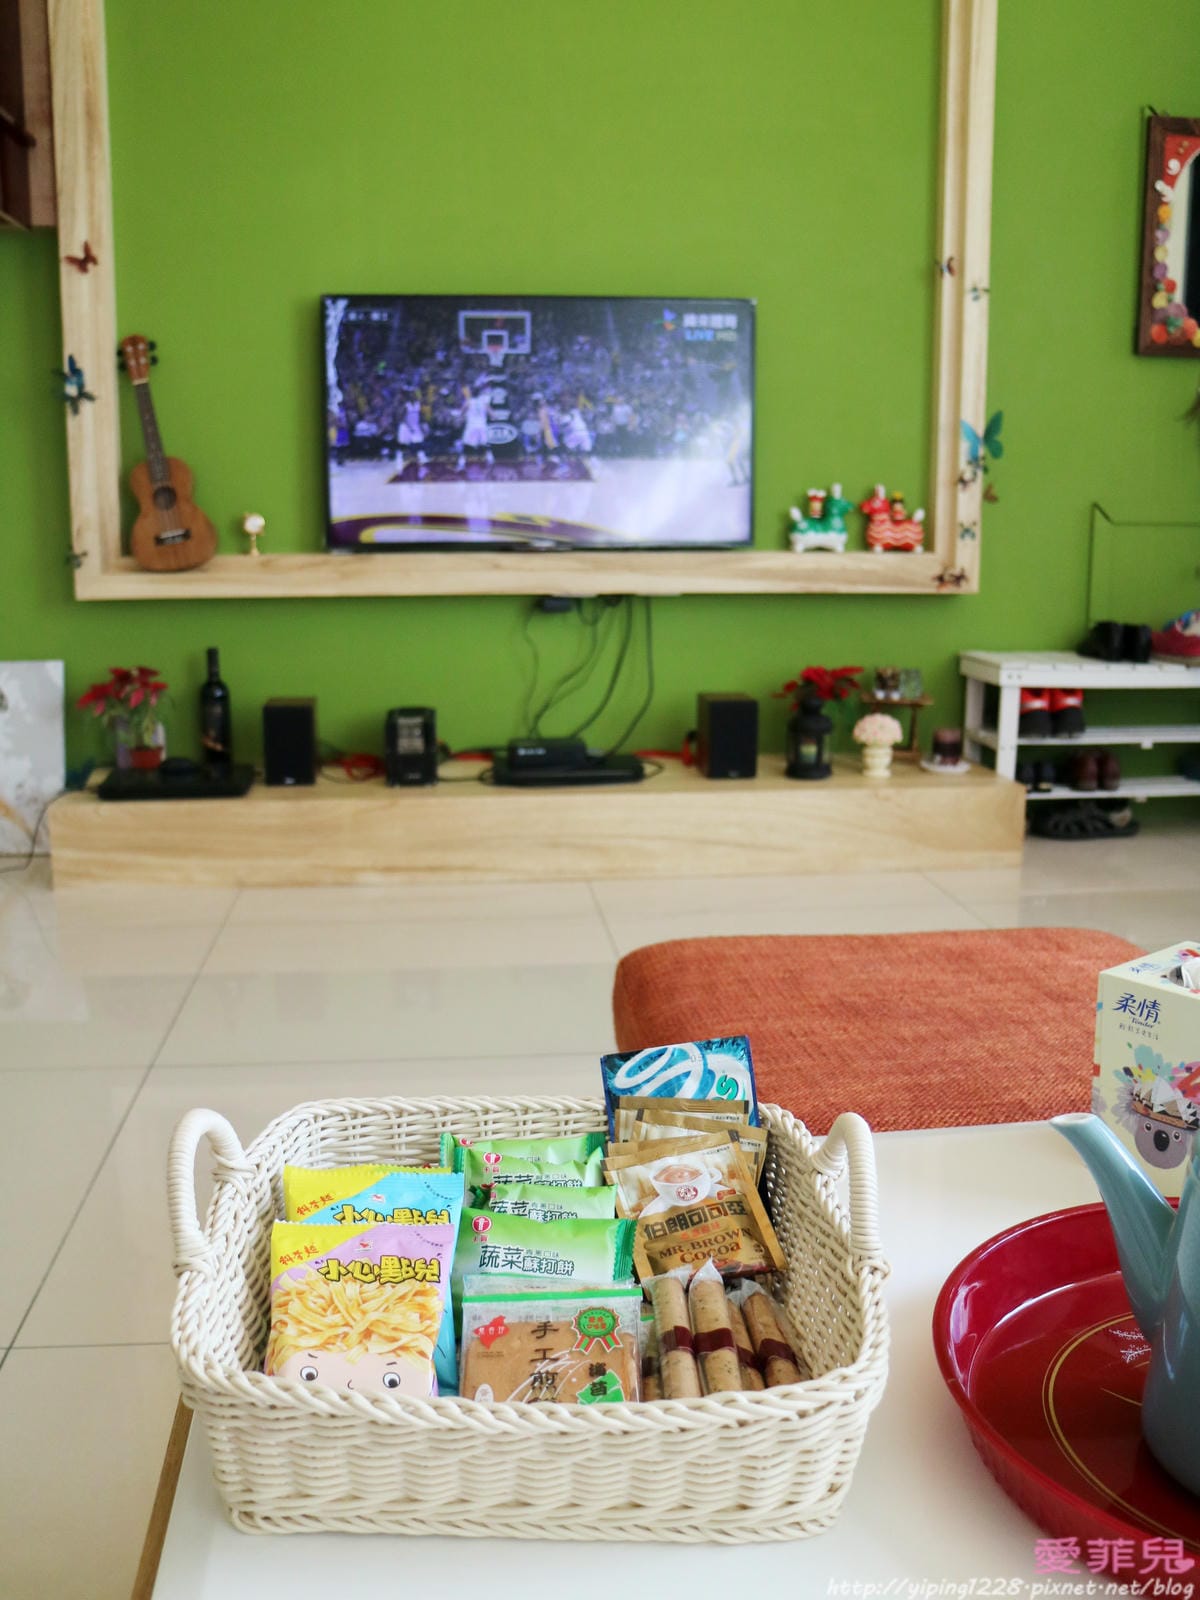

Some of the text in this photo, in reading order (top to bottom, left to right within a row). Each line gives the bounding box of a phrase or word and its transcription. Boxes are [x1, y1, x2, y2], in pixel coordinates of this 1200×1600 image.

[1112, 992, 1161, 1023] 柔情
[644, 1200, 748, 1240] 伯朗可可亞
[680, 1241, 741, 1264] Cocoa
[690, 1227, 753, 1250] BROWN
[317, 1255, 440, 1284] 小心點兒
